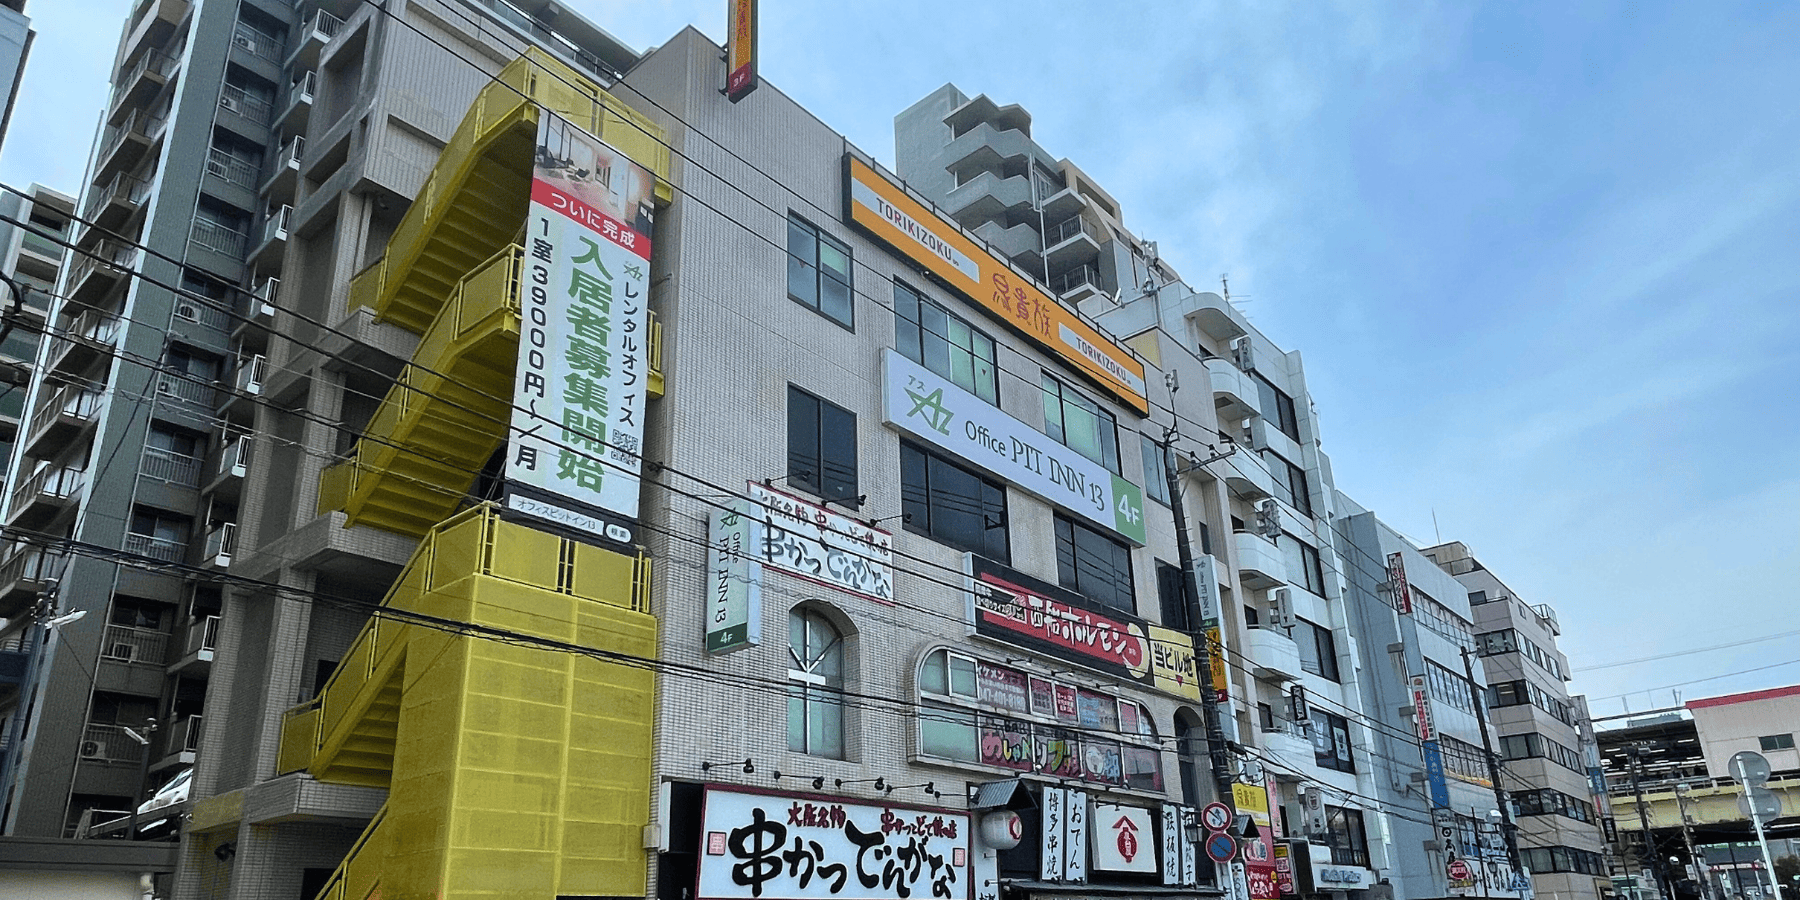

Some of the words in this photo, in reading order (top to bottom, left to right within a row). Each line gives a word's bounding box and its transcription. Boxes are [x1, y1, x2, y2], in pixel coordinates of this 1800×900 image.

[551, 192, 636, 249] ついに完成
[876, 197, 952, 261] TORIKIZOKU
[556, 235, 614, 494] 入居者募集開始
[619, 282, 639, 427] レンタルオフィス
[1076, 336, 1127, 381] TORIKIZOKU
[965, 420, 1006, 457] Office
[1009, 435, 1042, 476] PIT
[1047, 456, 1086, 498] INN
[1088, 482, 1105, 512] 13
[1118, 494, 1140, 526] 4F
[717, 566, 729, 603] INN
[714, 607, 727, 624] 13
[719, 631, 733, 644] 4F
[786, 801, 847, 829] 大阪名物
[727, 807, 957, 899] 串かつでんがな
